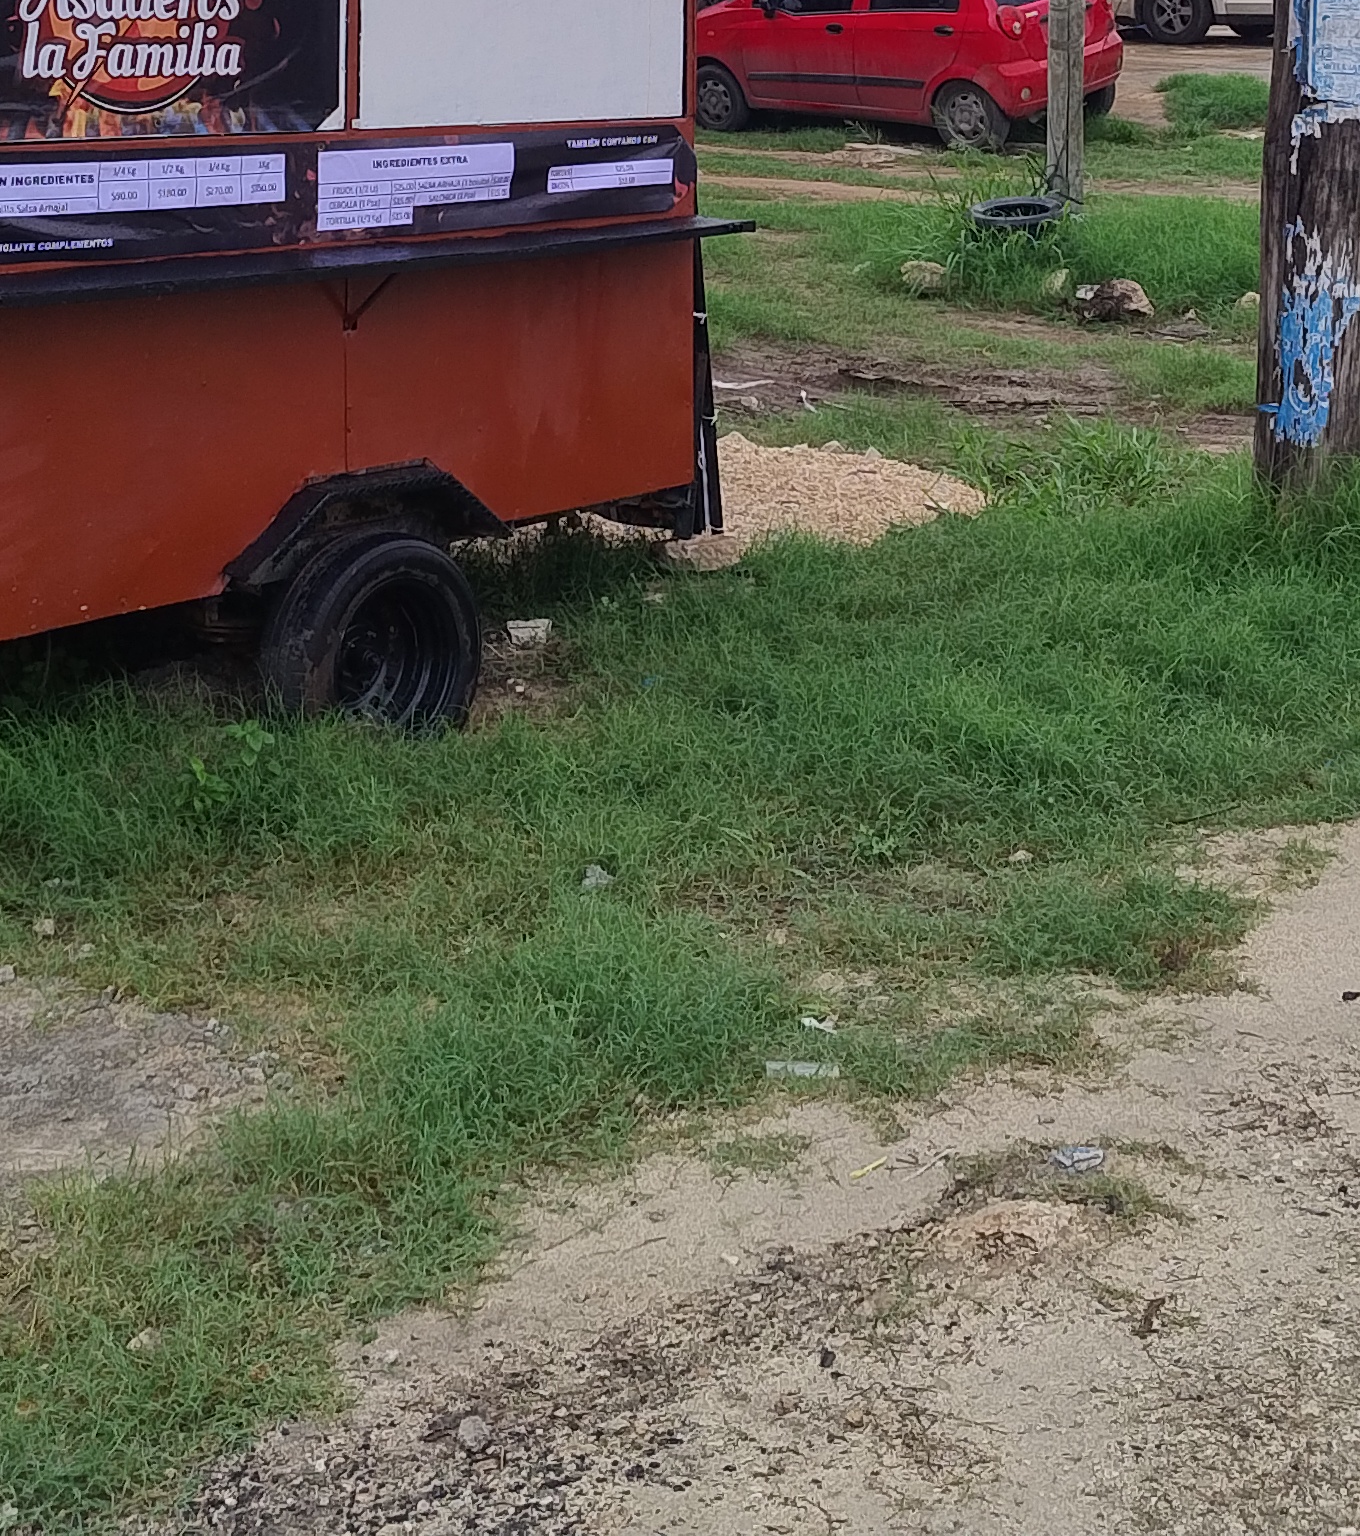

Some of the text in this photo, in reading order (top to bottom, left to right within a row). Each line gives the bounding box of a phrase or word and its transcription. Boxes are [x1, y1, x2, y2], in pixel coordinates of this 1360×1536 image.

[22, 21, 242, 80] la Familia
[372, 155, 469, 169] INGREDIENTES EXTRA
[10, 174, 95, 187] INGREDIENTES
[37, 238, 114, 251] COMPLEMENTOS
